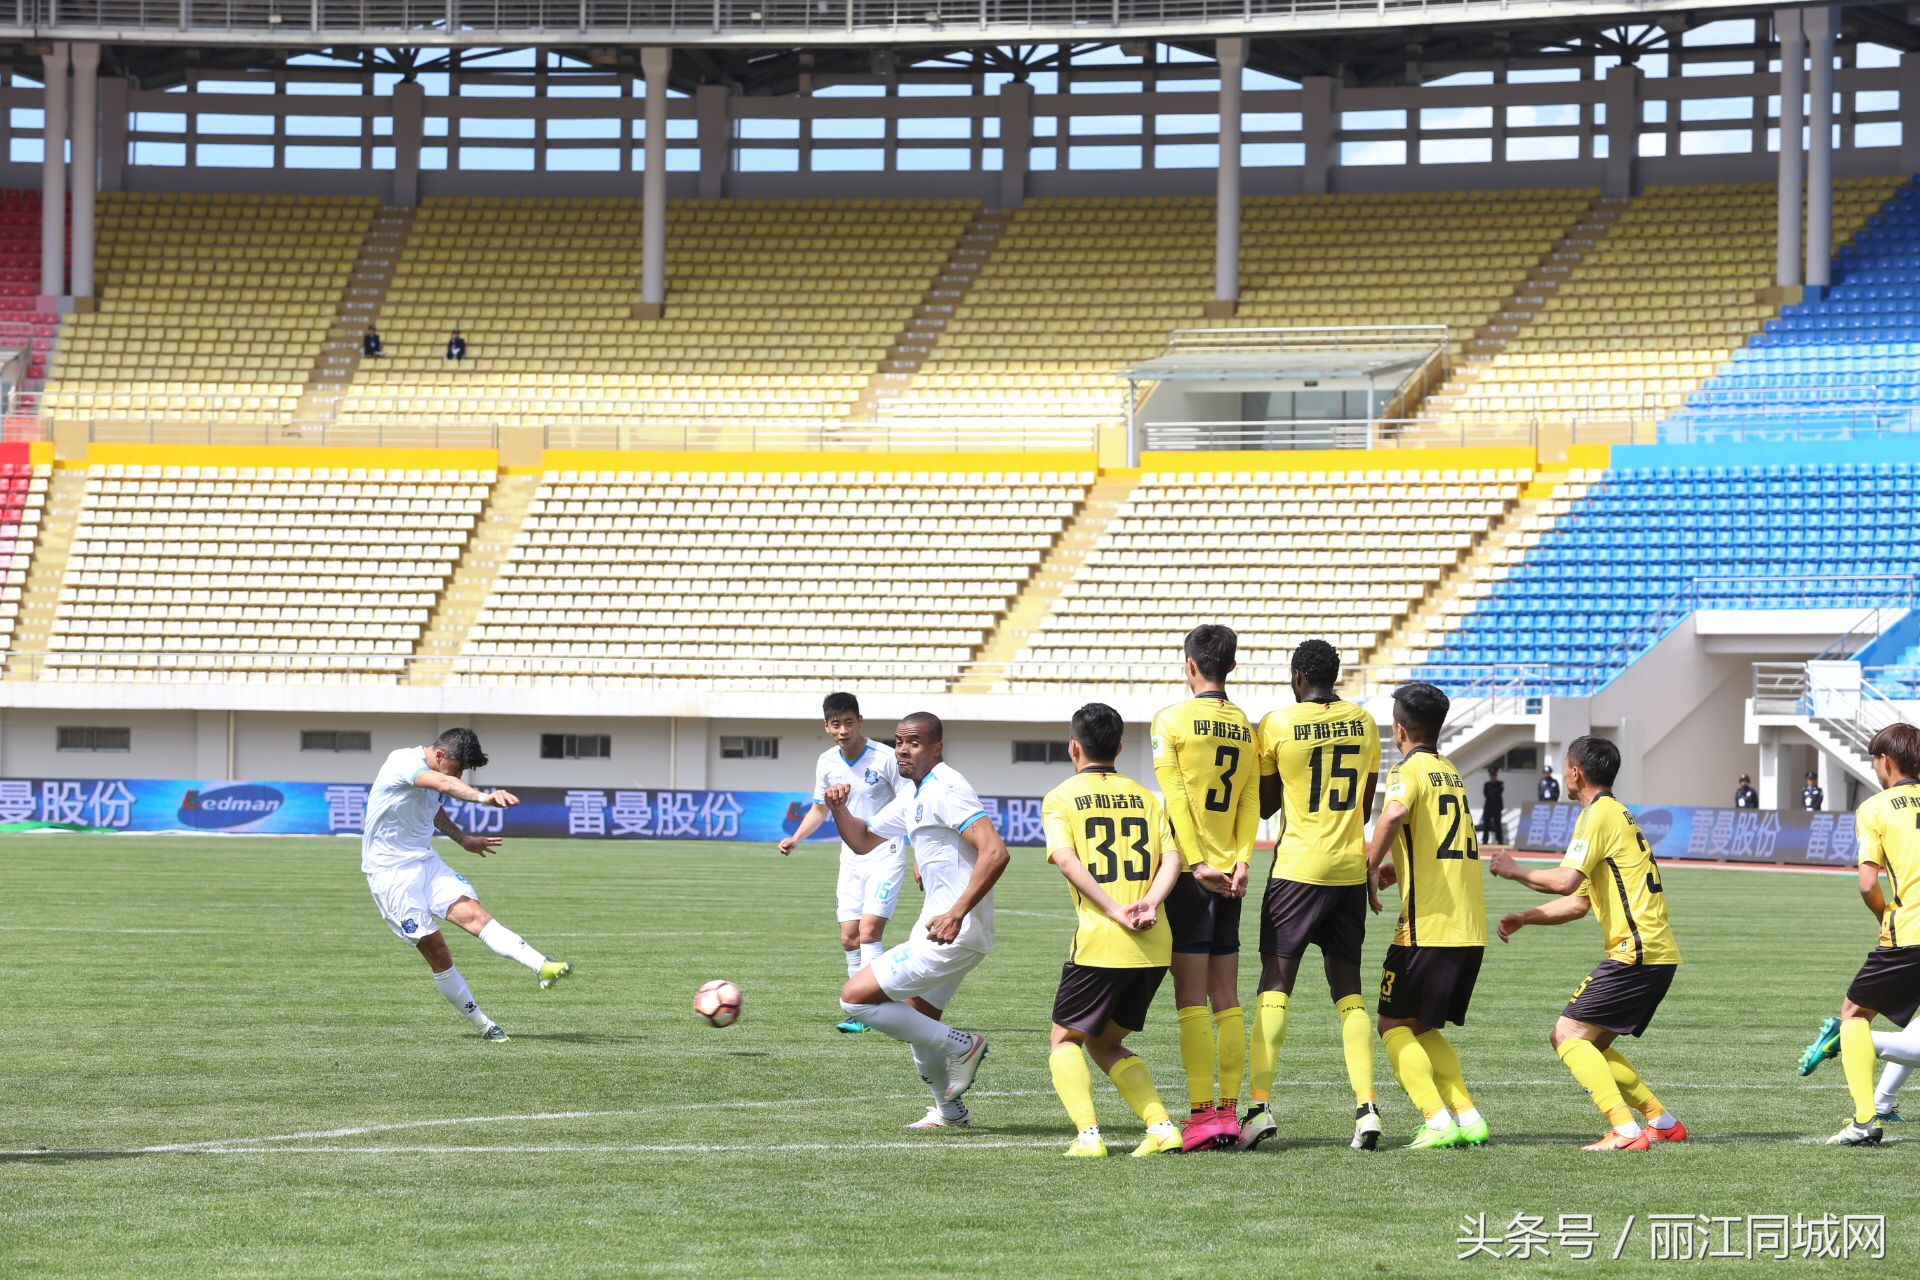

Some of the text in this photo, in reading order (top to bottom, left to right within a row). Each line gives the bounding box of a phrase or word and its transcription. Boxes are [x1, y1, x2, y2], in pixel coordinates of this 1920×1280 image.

[1193, 719, 1253, 744] 呼和浩特
[1293, 720, 1365, 742] 呼和浩特
[182, 789, 281, 812] Ledman
[1073, 793, 1145, 811] 呼和浩特
[1205, 745, 1240, 813] 3
[1308, 744, 1361, 813] 15
[564, 790, 744, 837] 雷曼股份
[1687, 809, 1781, 859] 雷曼股份
[1085, 816, 1151, 884] 33
[1806, 814, 1859, 861] 雷曼
